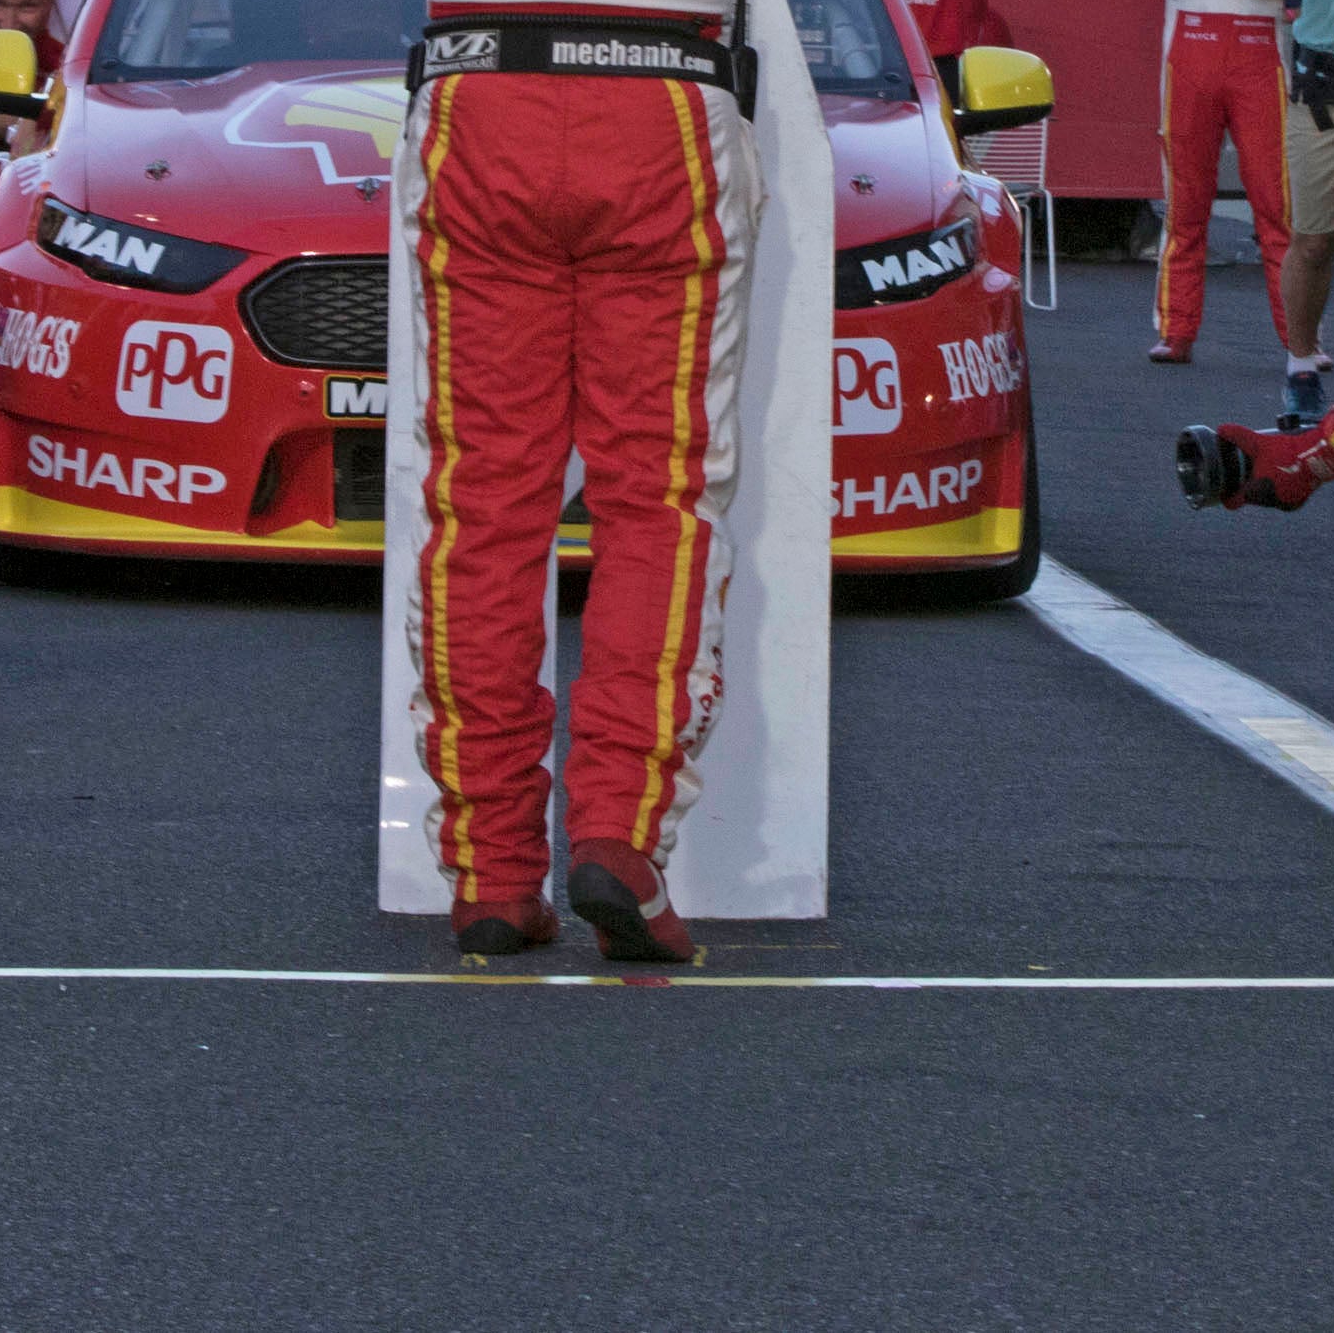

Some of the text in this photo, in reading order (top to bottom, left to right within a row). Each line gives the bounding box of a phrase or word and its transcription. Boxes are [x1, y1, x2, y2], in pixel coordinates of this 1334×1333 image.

[56, 215, 165, 275] MAN
[861, 235, 966, 292] MAN
[27, 434, 228, 505] SHARP
